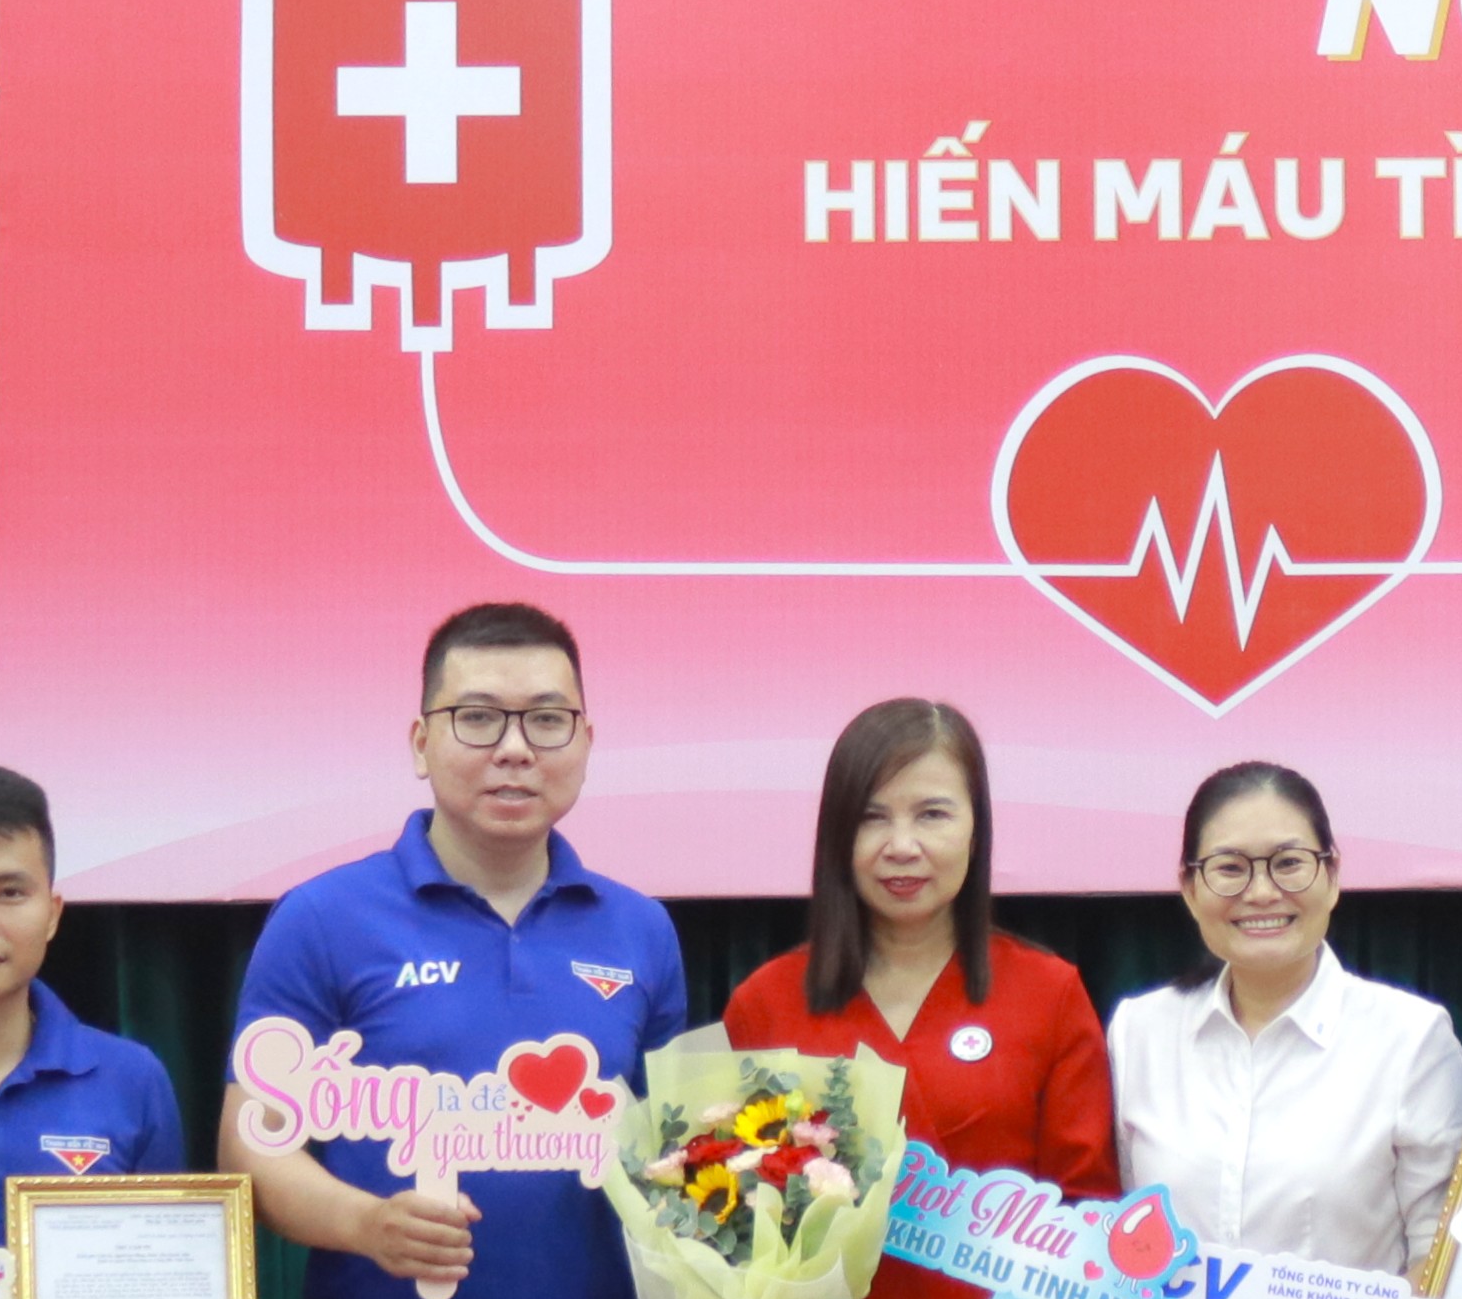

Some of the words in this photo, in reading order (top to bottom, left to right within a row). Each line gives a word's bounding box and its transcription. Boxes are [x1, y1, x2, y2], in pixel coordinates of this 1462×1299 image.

[805, 121, 1059, 242] HIẾN
[1094, 132, 1344, 240] MÁU
[396, 961, 461, 988] ACV
[244, 1027, 434, 1166] Sống
[437, 1084, 460, 1112] là
[472, 1084, 509, 1112] để
[432, 1122, 491, 1179] yêu
[493, 1111, 611, 1178] thương
[885, 1218, 947, 1260] KHO
[952, 1241, 1014, 1283] BÁU
[968, 1179, 1078, 1260] Máu
[1267, 1283, 1303, 1299] HÀNG
[1271, 1265, 1304, 1283] TỔNG
[1308, 1273, 1342, 1290] CÔNG
[1346, 1281, 1361, 1292] TY
[1365, 1280, 1399, 1299] CẢNG
